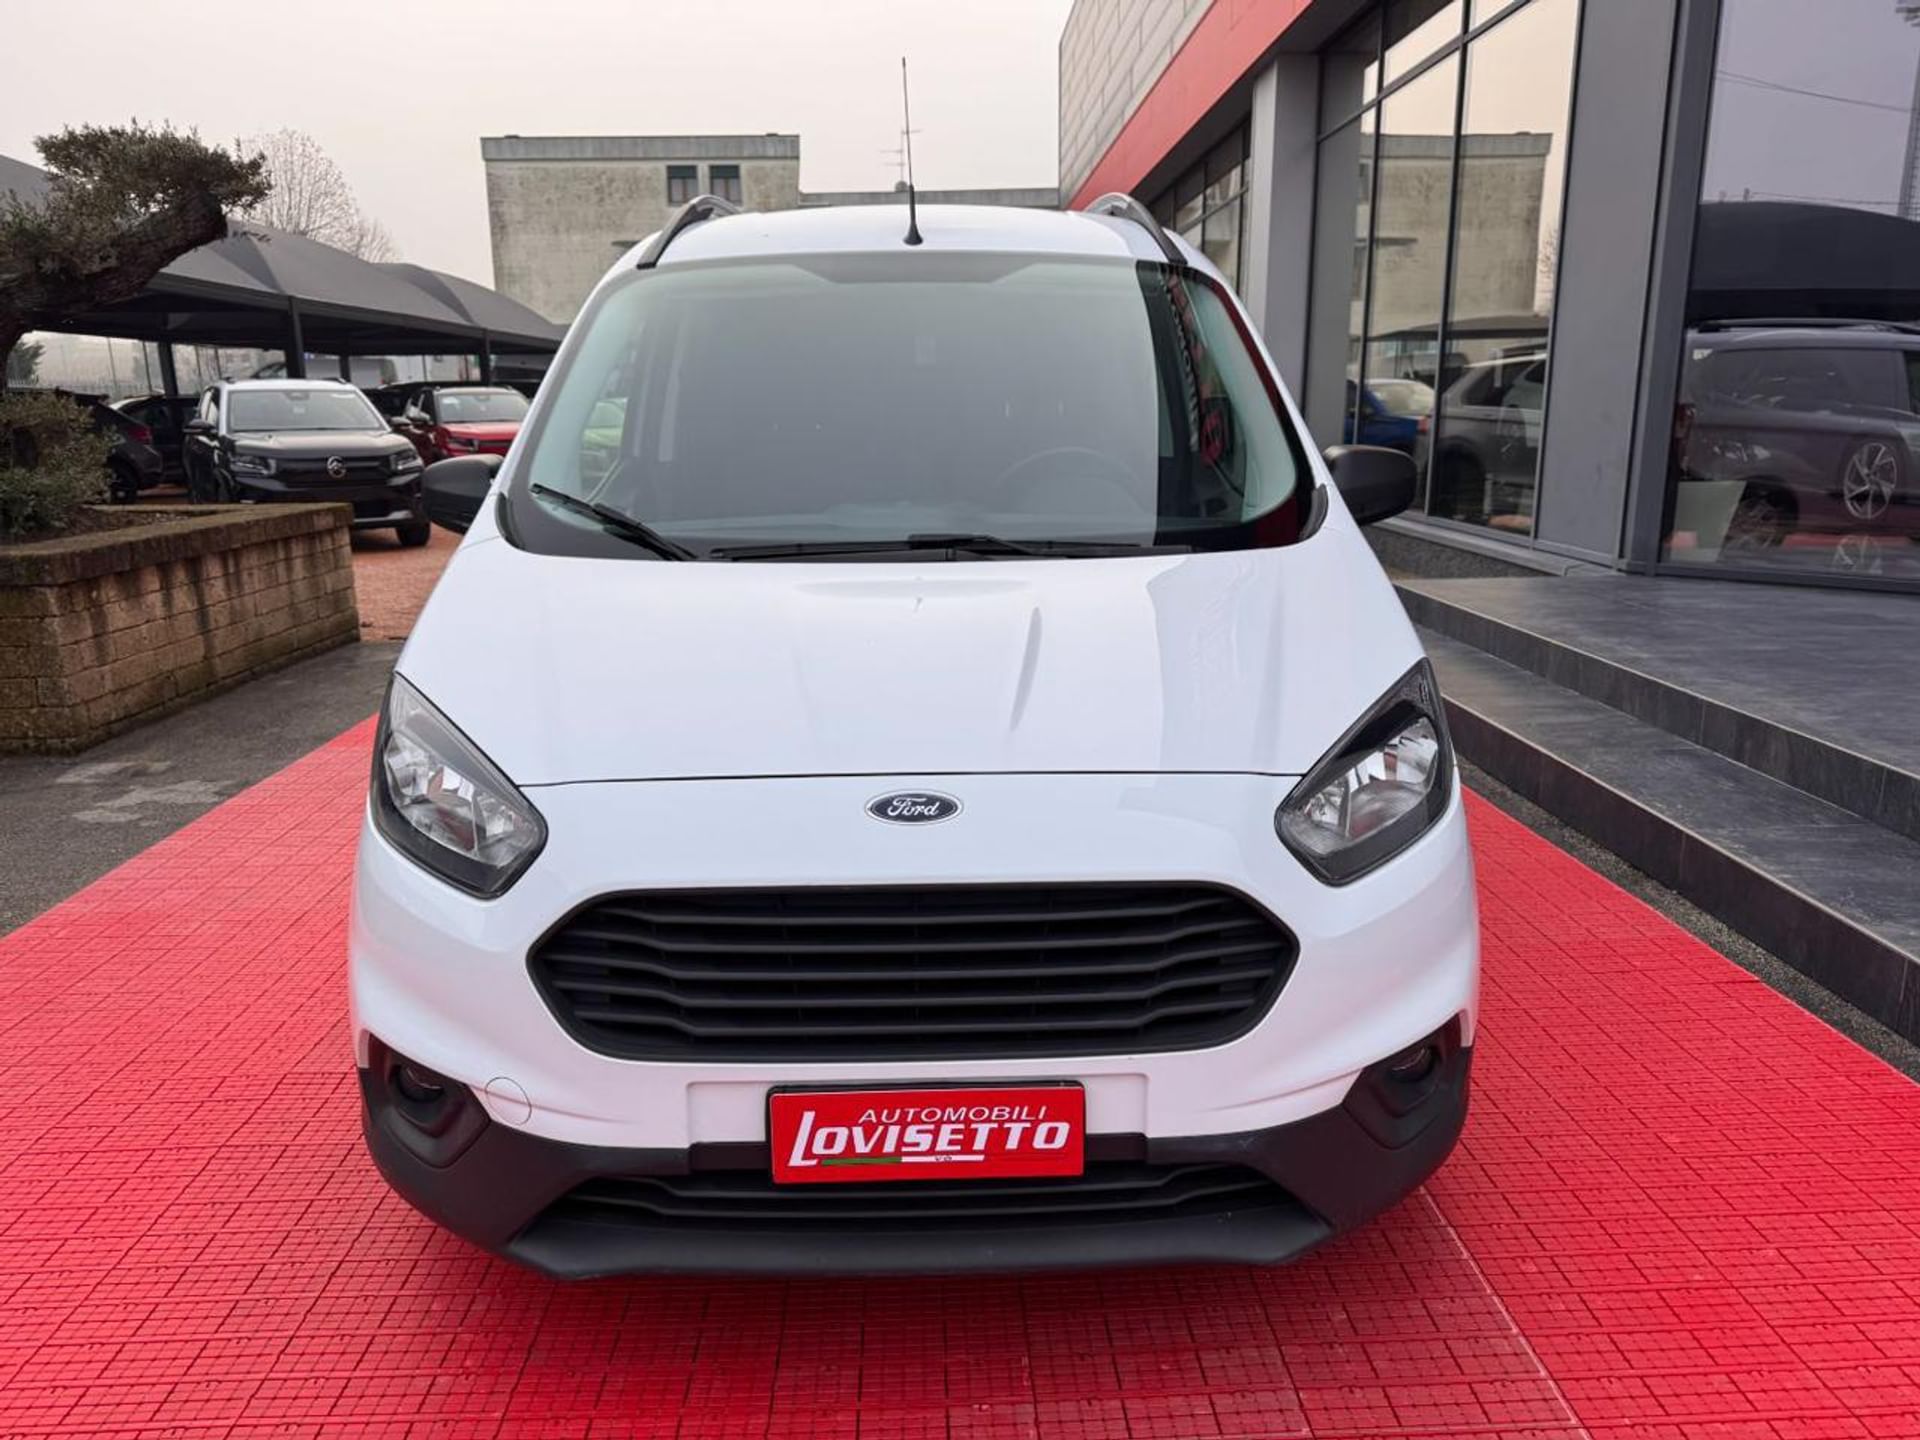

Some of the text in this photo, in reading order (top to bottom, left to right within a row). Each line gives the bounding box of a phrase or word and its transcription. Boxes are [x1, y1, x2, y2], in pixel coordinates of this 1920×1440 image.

[887, 797, 940, 816] Ford
[858, 1106, 1047, 1124] AUTOMOBILI
[788, 1111, 1071, 1167] LOVISETTO
